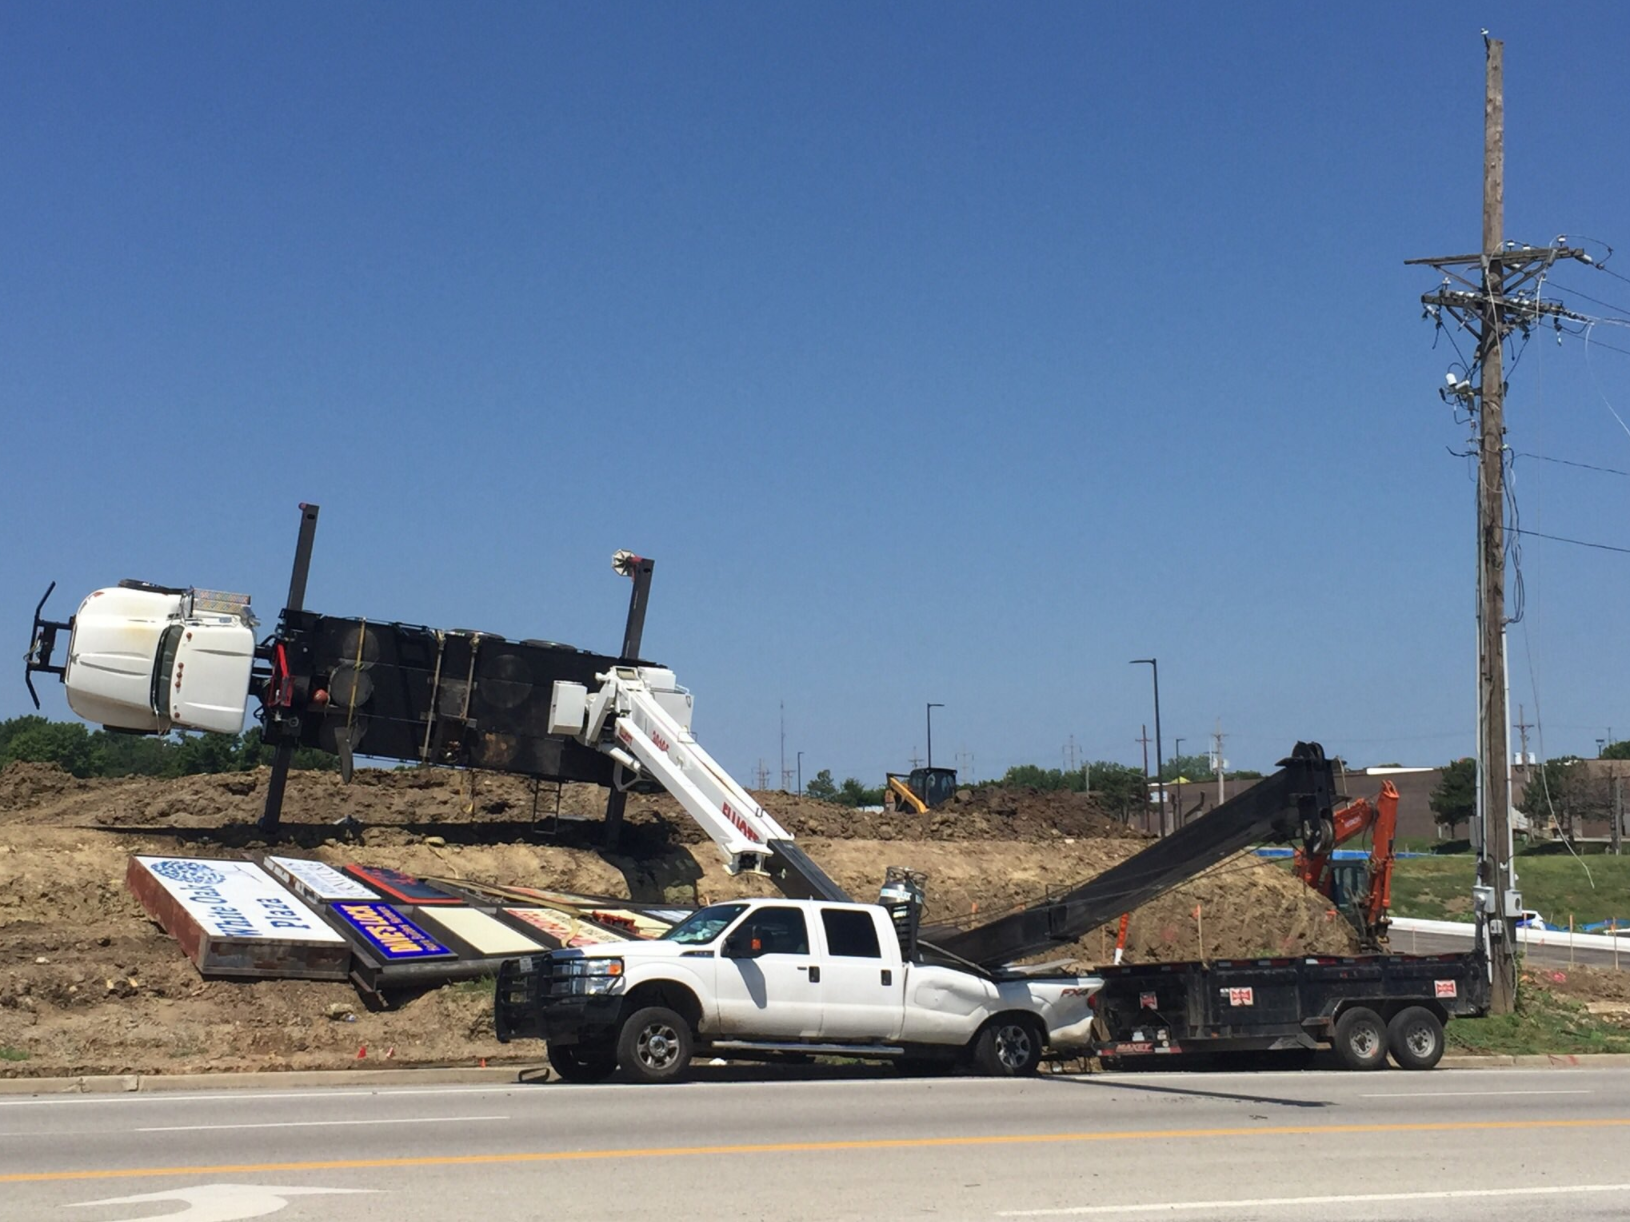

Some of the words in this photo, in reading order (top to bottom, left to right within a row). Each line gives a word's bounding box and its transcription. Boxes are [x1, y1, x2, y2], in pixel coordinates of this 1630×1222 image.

[179, 884, 228, 904] Oak
[206, 906, 263, 937] White
[256, 898, 311, 929] Plaza
[1061, 988, 1090, 998] FX4
[1115, 1042, 1154, 1053] MAXEY
